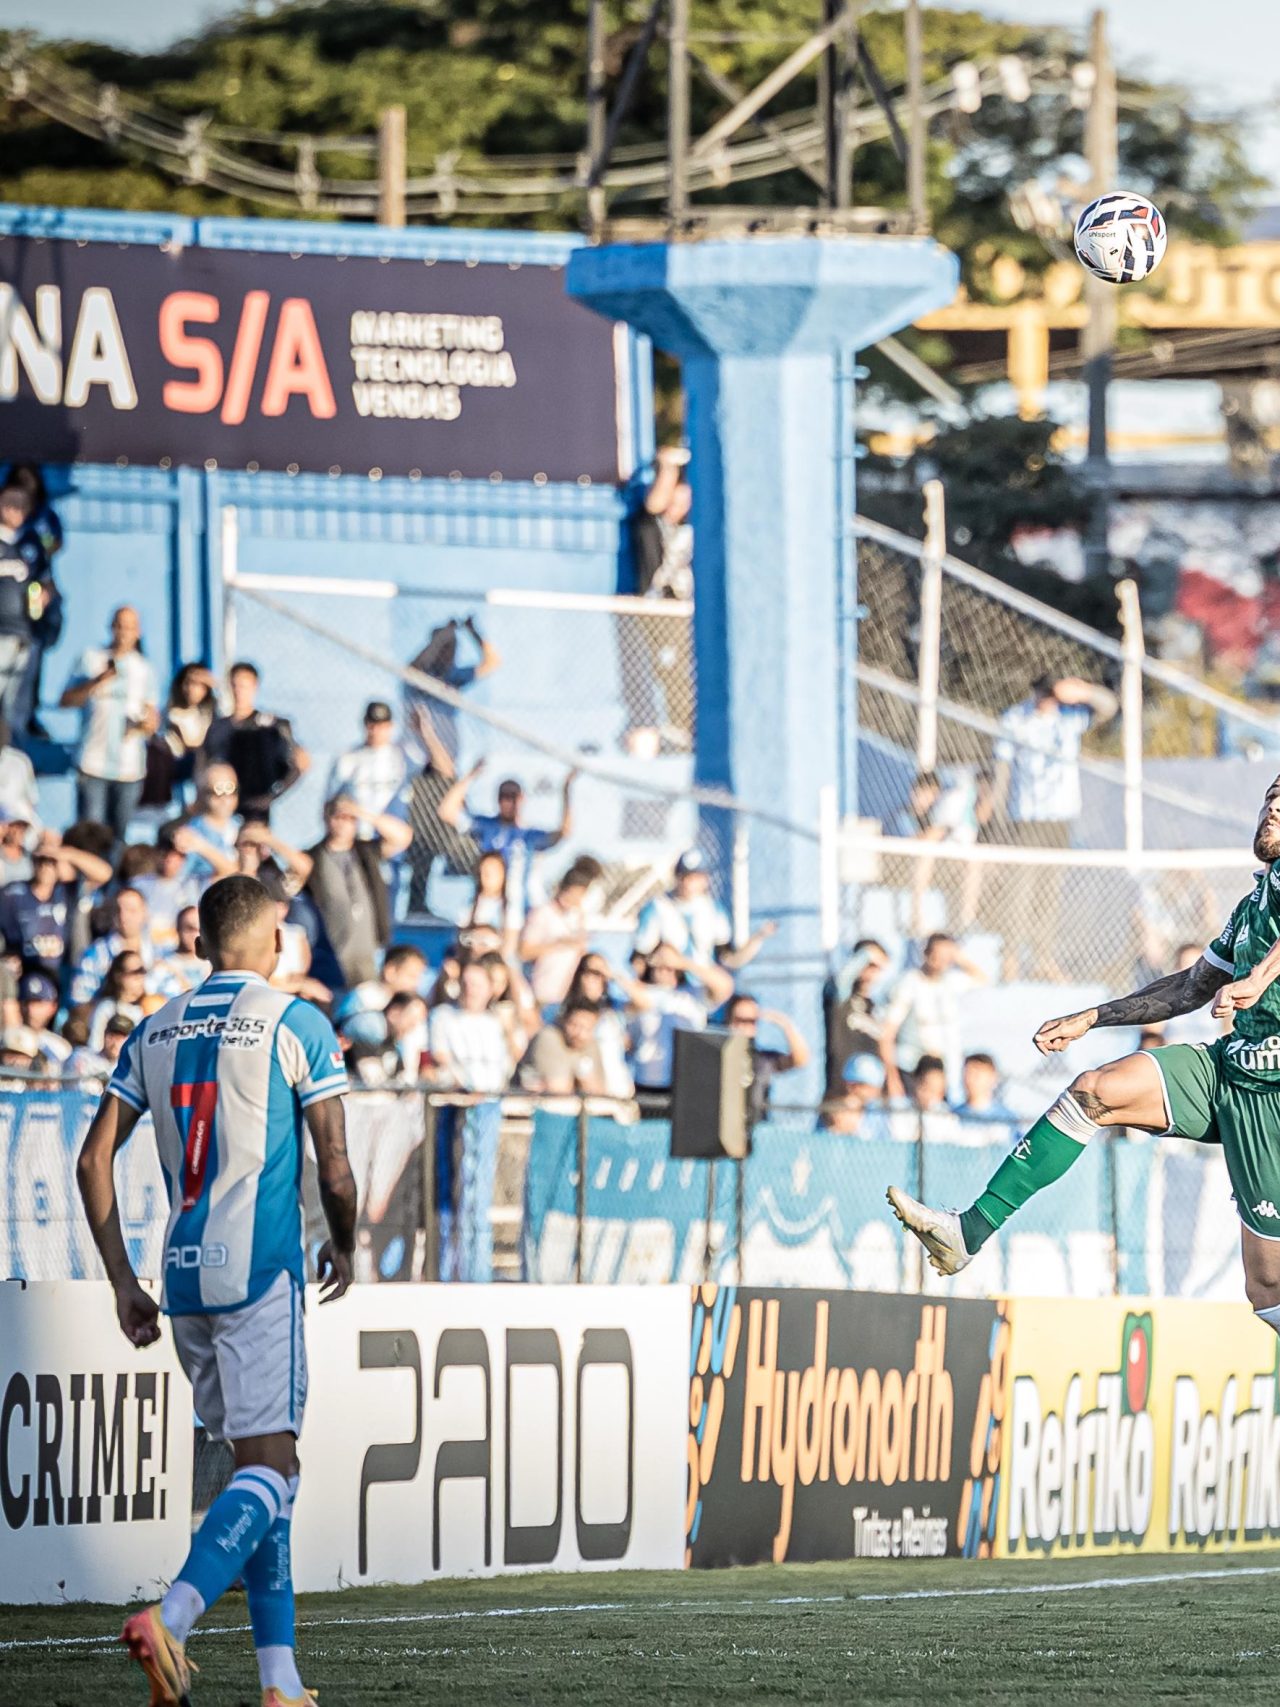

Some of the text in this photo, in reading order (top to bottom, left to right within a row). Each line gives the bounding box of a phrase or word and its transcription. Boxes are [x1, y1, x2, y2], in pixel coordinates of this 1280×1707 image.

[1088, 231, 1116, 239] uhlsport
[159, 289, 337, 426] S/A
[350, 345, 517, 388] TECNOLOGIA
[351, 310, 504, 352] MARKETING
[352, 380, 462, 421] VENDAS
[170, 1082, 218, 1213] 7
[164, 1243, 228, 1270] ADO
[0, 1371, 170, 1530] CRIME!
[359, 1328, 634, 1575] PADO
[741, 1299, 954, 1563] Hydronorth
[1008, 1373, 1154, 1552] Refriko
